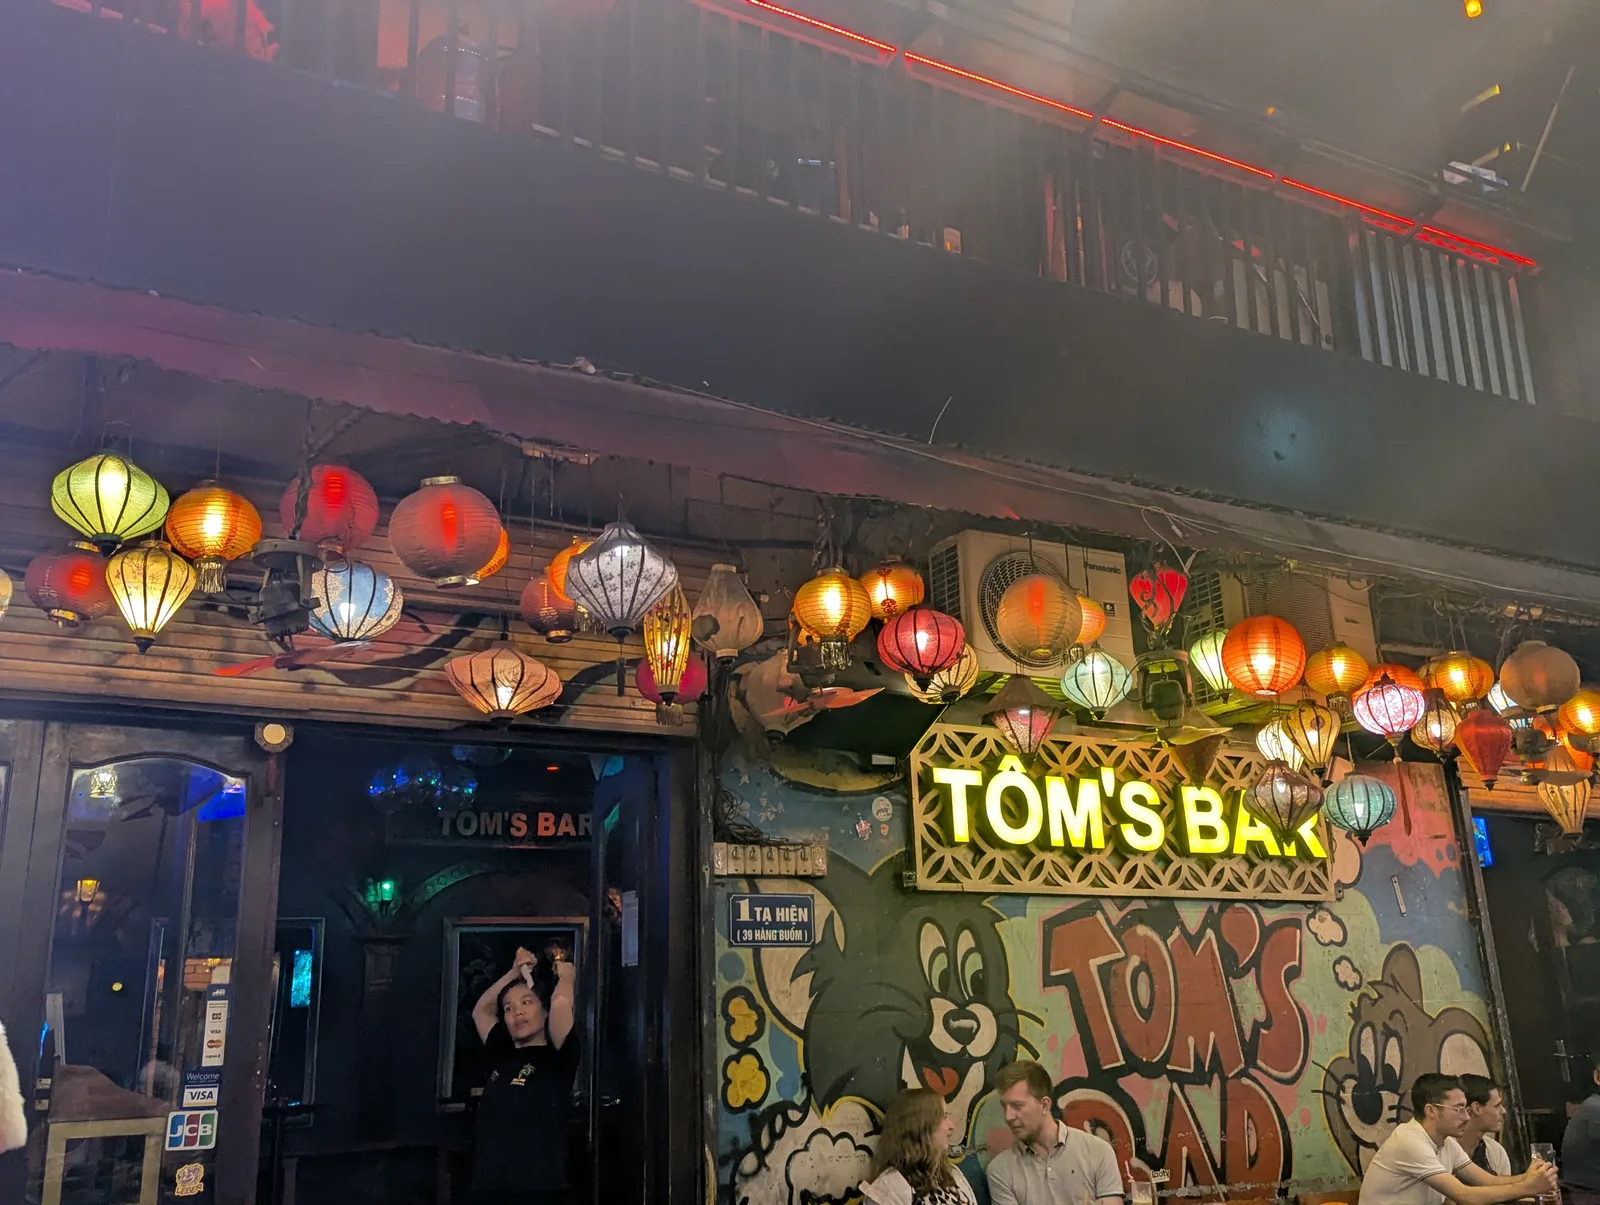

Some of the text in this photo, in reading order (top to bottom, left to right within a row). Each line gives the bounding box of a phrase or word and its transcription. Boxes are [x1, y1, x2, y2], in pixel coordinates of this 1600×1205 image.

[439, 811, 528, 837] TOM'S
[736, 898, 808, 925] 1 TẠ HIỆN
[755, 927, 777, 940] HÀNG
[1043, 902, 1308, 1083] TOM'S
[186, 1072, 220, 1080] Welcome
[190, 1091, 213, 1100] VISA
[169, 1124, 212, 1137] JCB
